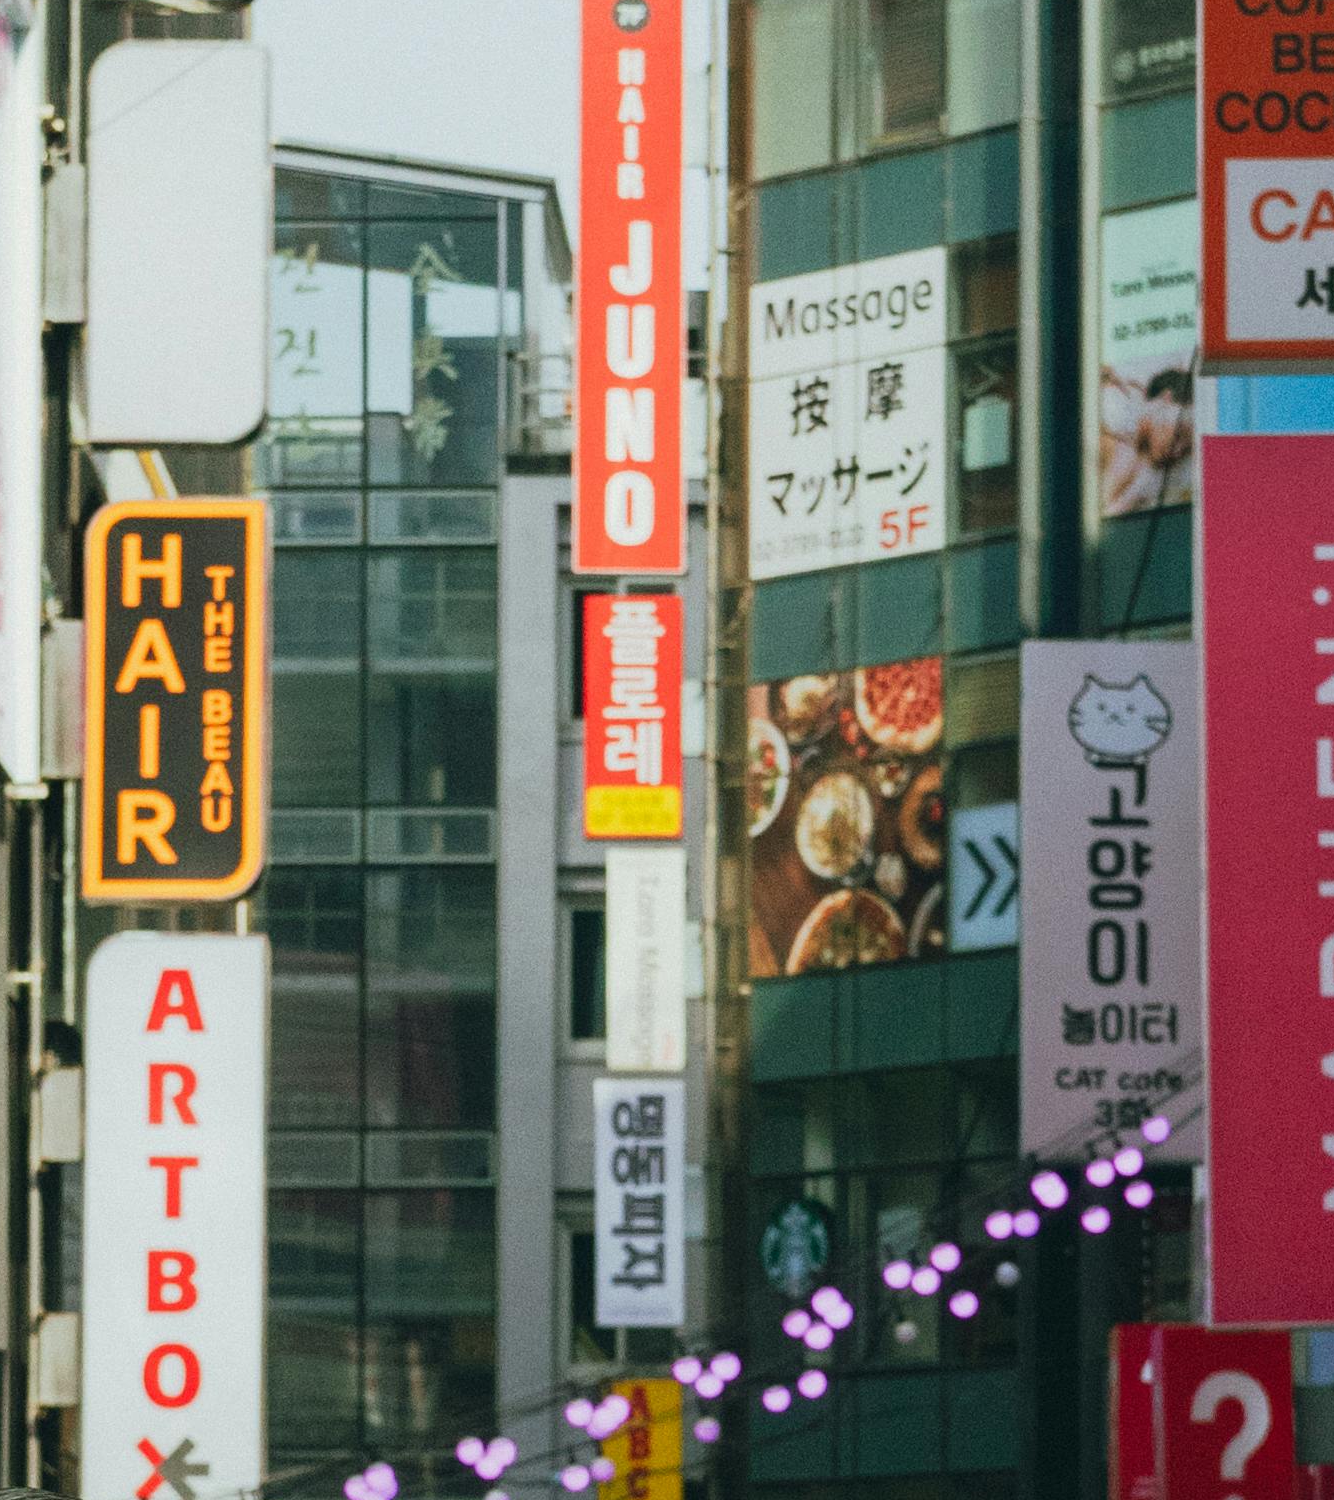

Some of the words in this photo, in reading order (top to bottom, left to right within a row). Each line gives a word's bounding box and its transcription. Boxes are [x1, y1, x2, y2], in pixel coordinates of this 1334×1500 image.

[616, 47, 647, 200] HAIR
[765, 279, 933, 340] Massage
[603, 220, 656, 547] JUNO
[767, 441, 931, 515] マッサージ
[879, 503, 931, 549] 5F
[203, 565, 236, 673] THE
[114, 532, 187, 866] HAIR
[200, 687, 234, 834] BEAU
[1087, 760, 1153, 985] 고양이
[1056, 1067, 1106, 1091] CAT
